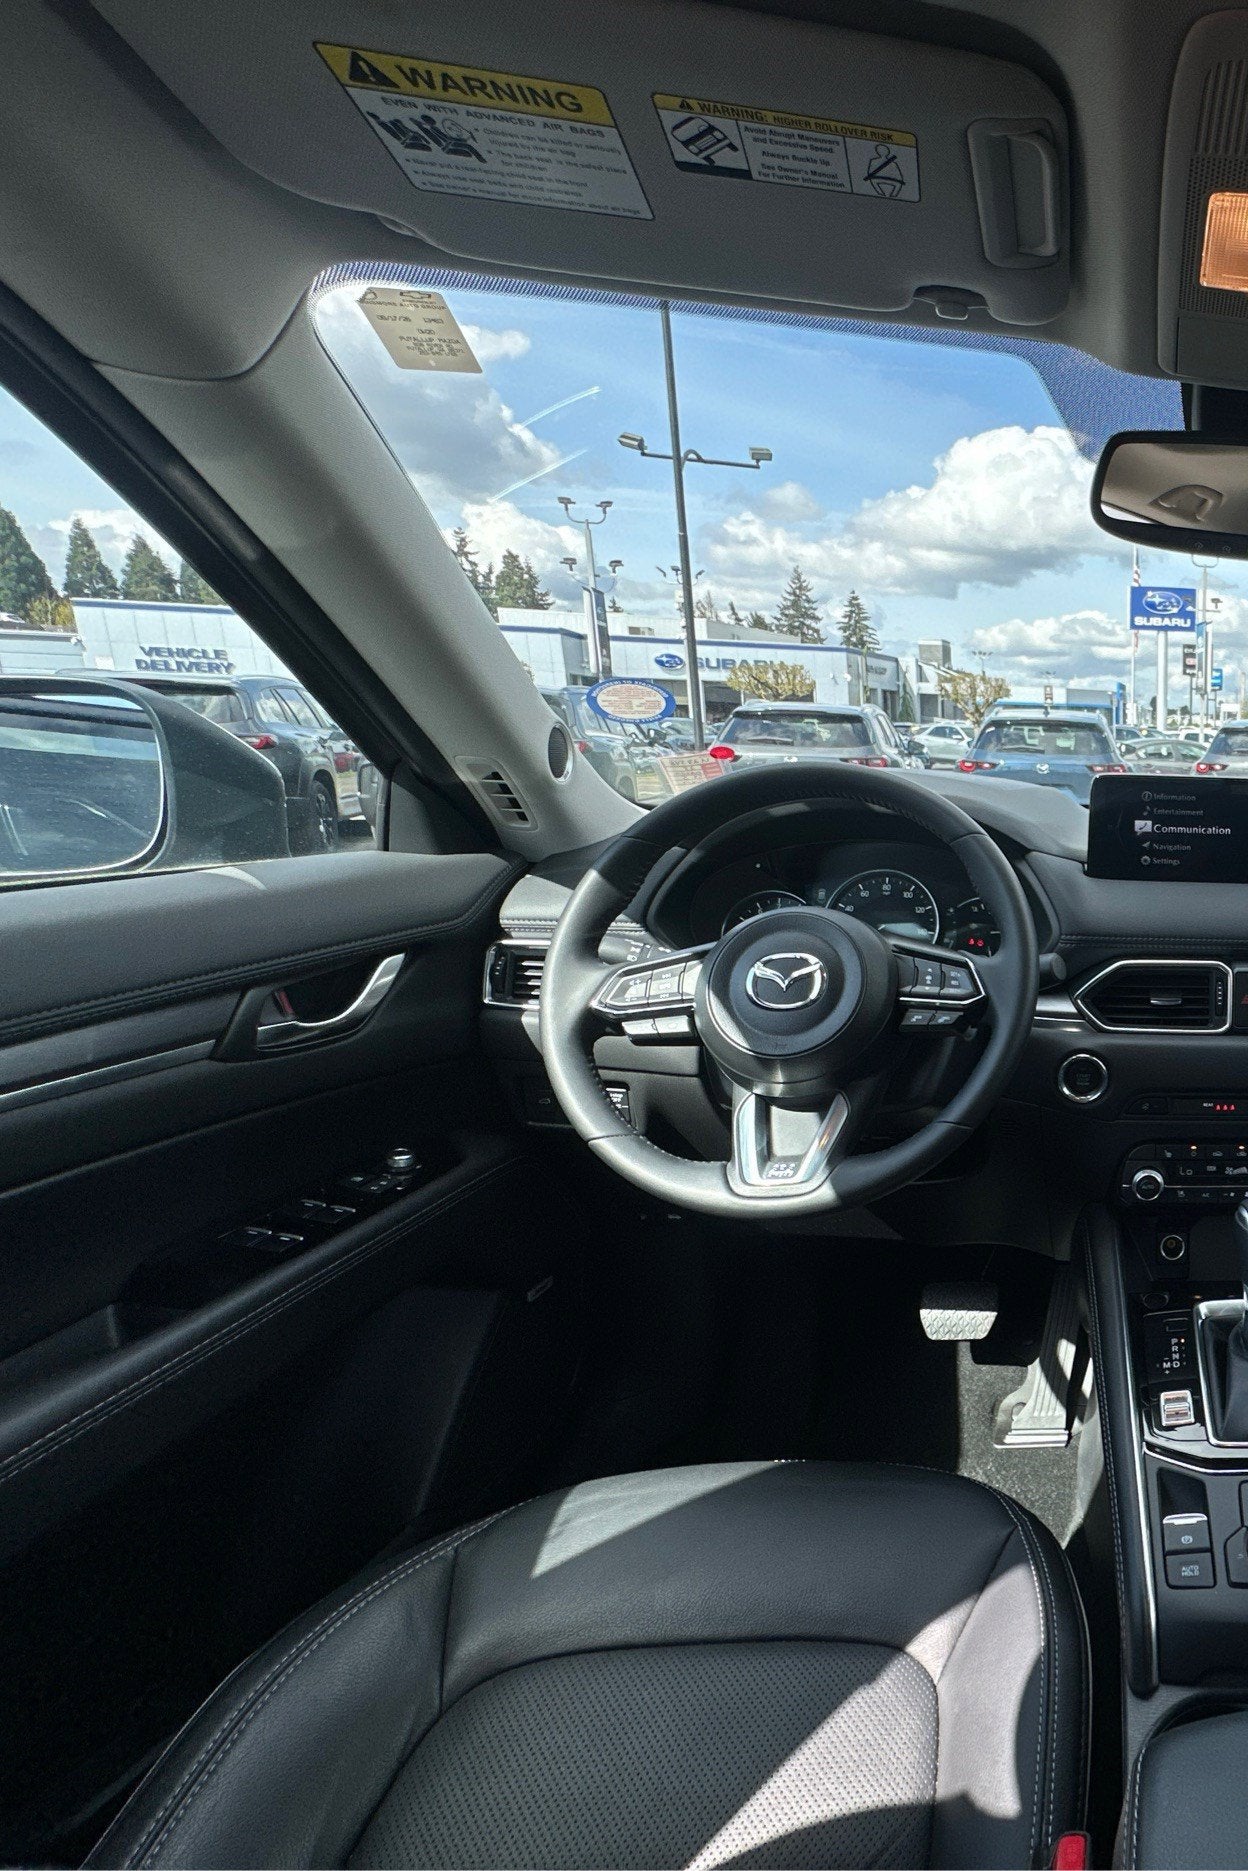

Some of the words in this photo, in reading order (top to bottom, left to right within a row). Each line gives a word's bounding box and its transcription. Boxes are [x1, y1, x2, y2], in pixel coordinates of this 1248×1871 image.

[396, 64, 583, 113] WARNING
[381, 96, 419, 111] EVEN
[423, 103, 459, 115] WITH
[466, 110, 536, 127] ADVANCED
[543, 121, 565, 132] AIR
[570, 125, 605, 138] BAGS
[698, 102, 770, 122] WARNING:
[773, 115, 813, 130] HIGHER
[815, 119, 869, 138] ROLLOVER
[870, 129, 895, 143] RISK
[1134, 616, 1192, 628] SUBARU
[139, 645, 228, 661] VEHICLE
[135, 659, 236, 675] DELIVERY
[1153, 792, 1197, 802] Information
[1154, 807, 1204, 817] Entertainment
[1154, 823, 1232, 836] Communication
[1153, 842, 1192, 852] Navigation
[1153, 857, 1181, 866] Settings
[860, 890, 870, 898] 60
[915, 906, 925, 914] 120
